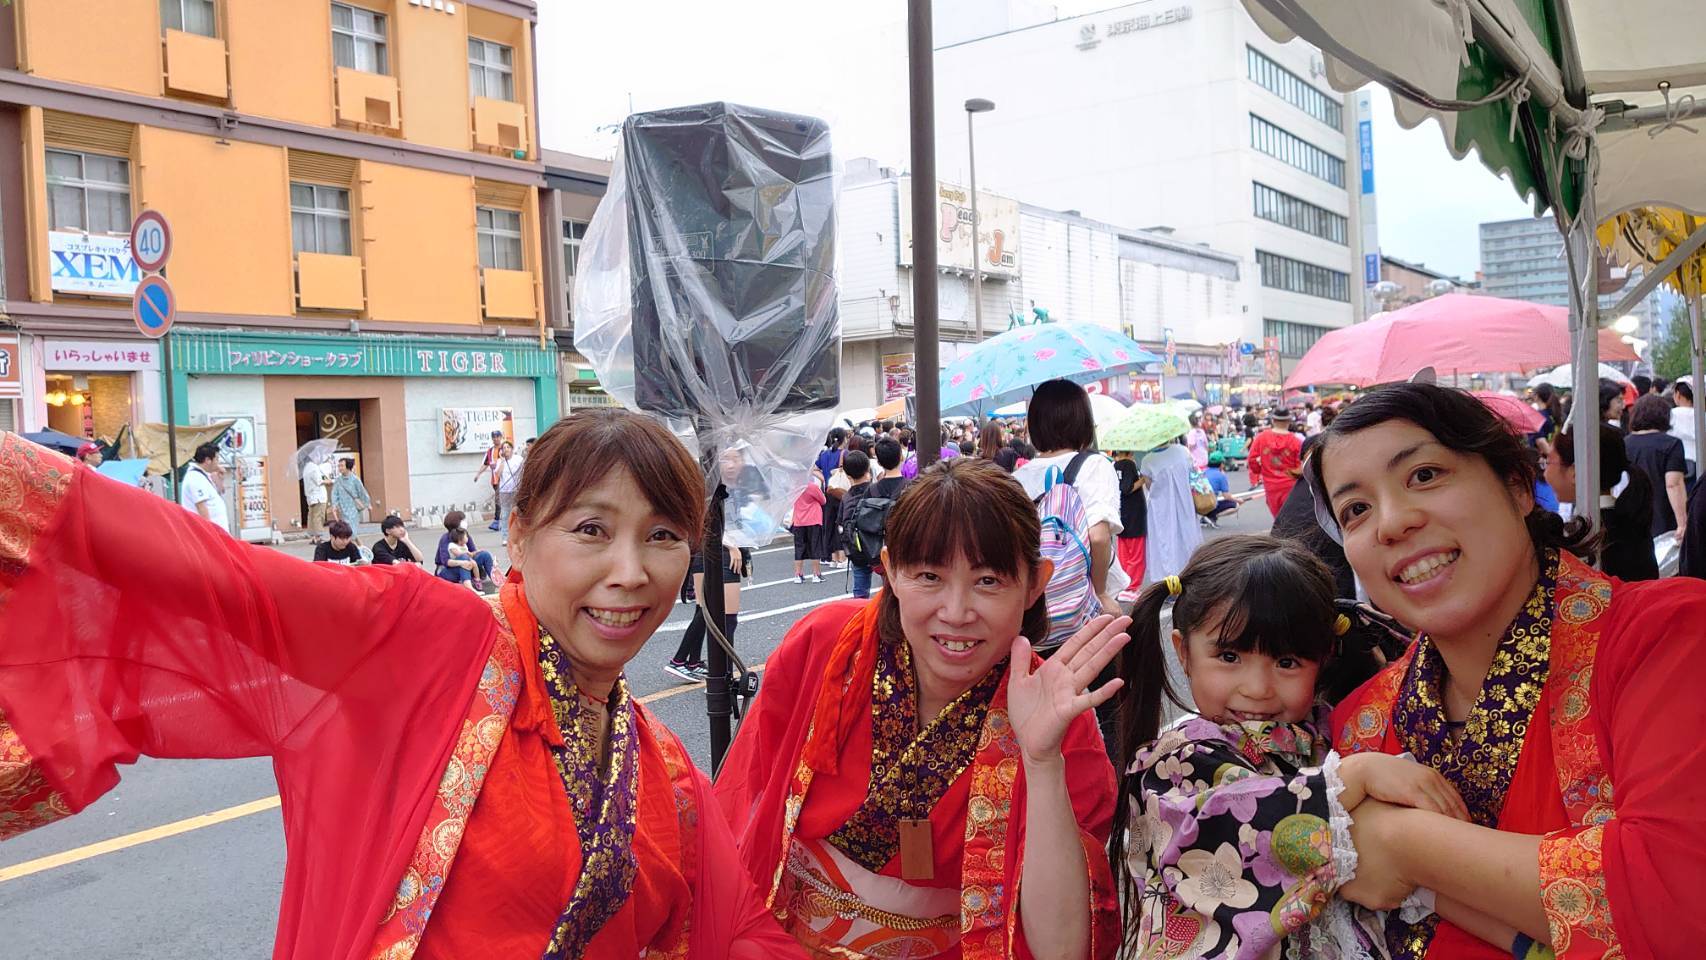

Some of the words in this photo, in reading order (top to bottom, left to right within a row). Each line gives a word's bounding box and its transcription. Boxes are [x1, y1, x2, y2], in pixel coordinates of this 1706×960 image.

[941, 202, 980, 242] Peac
[140, 228, 160, 255] 40
[52, 250, 141, 282] XEM
[54, 350, 151, 363] いらっしゃいませ
[418, 350, 507, 373] TIGER
